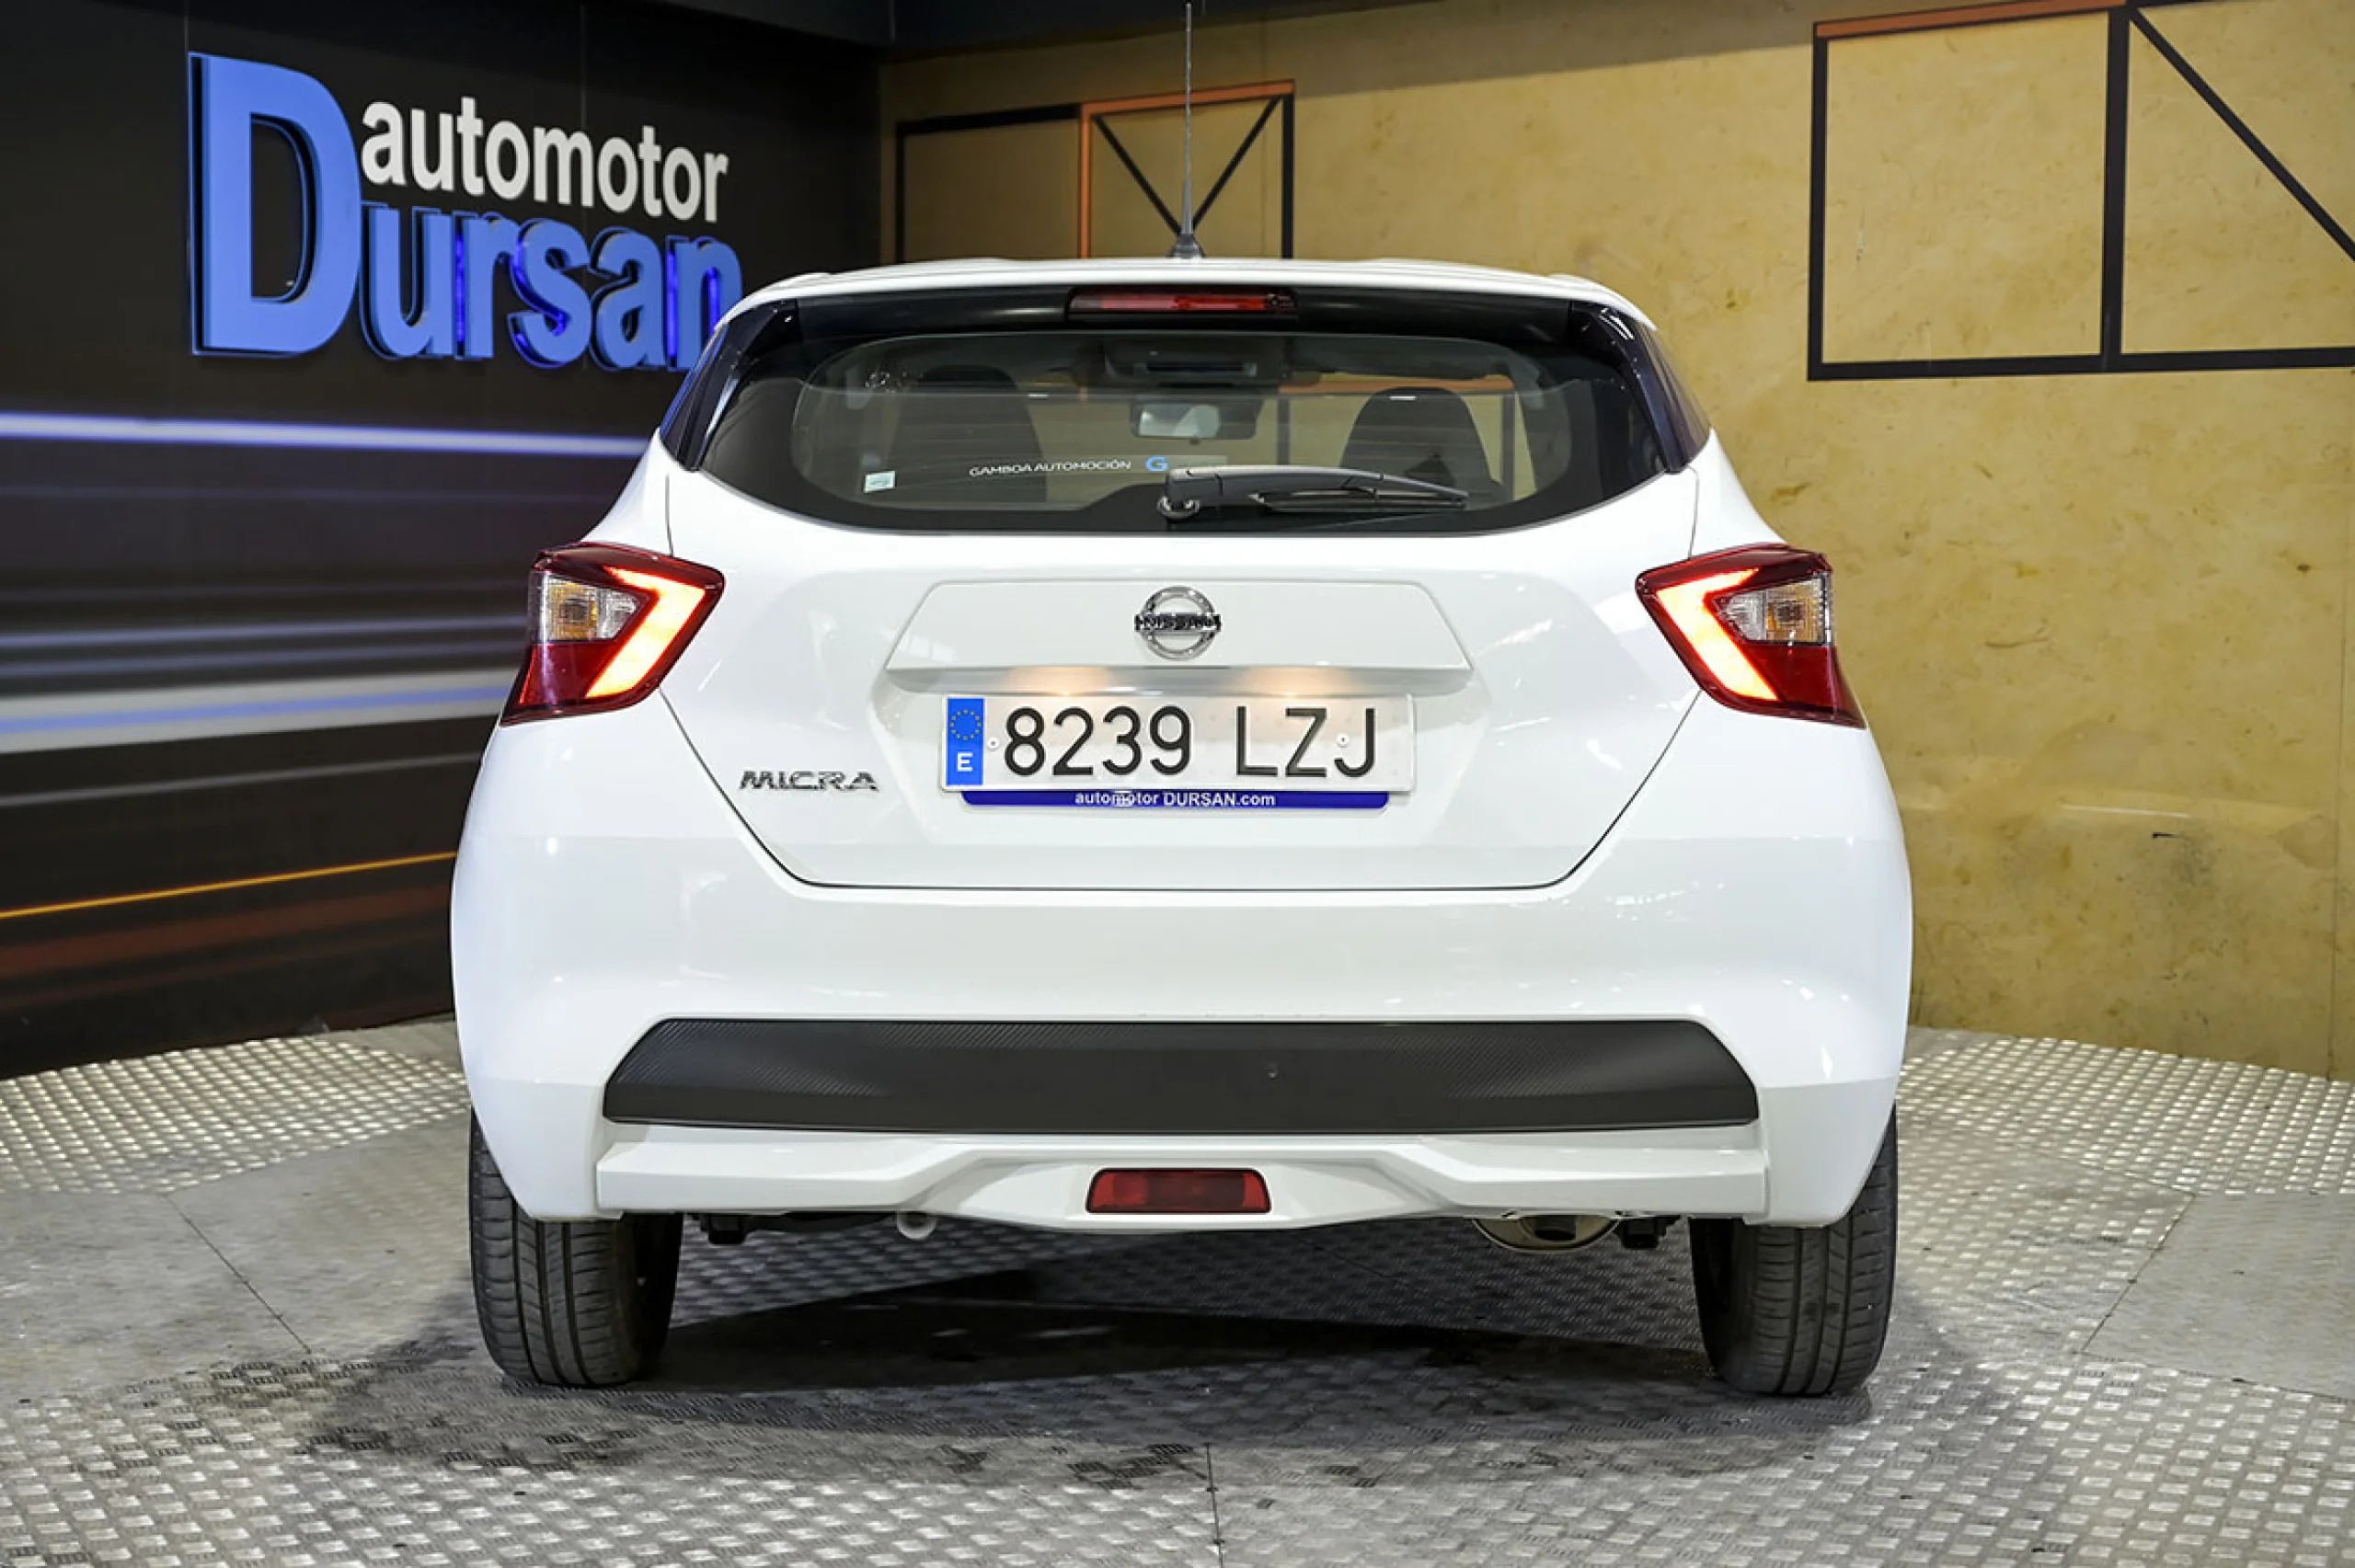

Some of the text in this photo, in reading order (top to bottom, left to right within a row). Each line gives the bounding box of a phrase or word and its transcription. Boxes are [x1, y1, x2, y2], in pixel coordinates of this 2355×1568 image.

[362, 97, 729, 222] automotor
[188, 52, 742, 370] Dursan
[969, 464, 1032, 476] GAMBOA
[1134, 613, 1221, 632] NISSAN
[1005, 705, 1376, 778] 8239 LZJ
[957, 752, 972, 772] E
[739, 771, 878, 791] MICRA
[1074, 792, 1276, 807] automotor DURSAN.com
